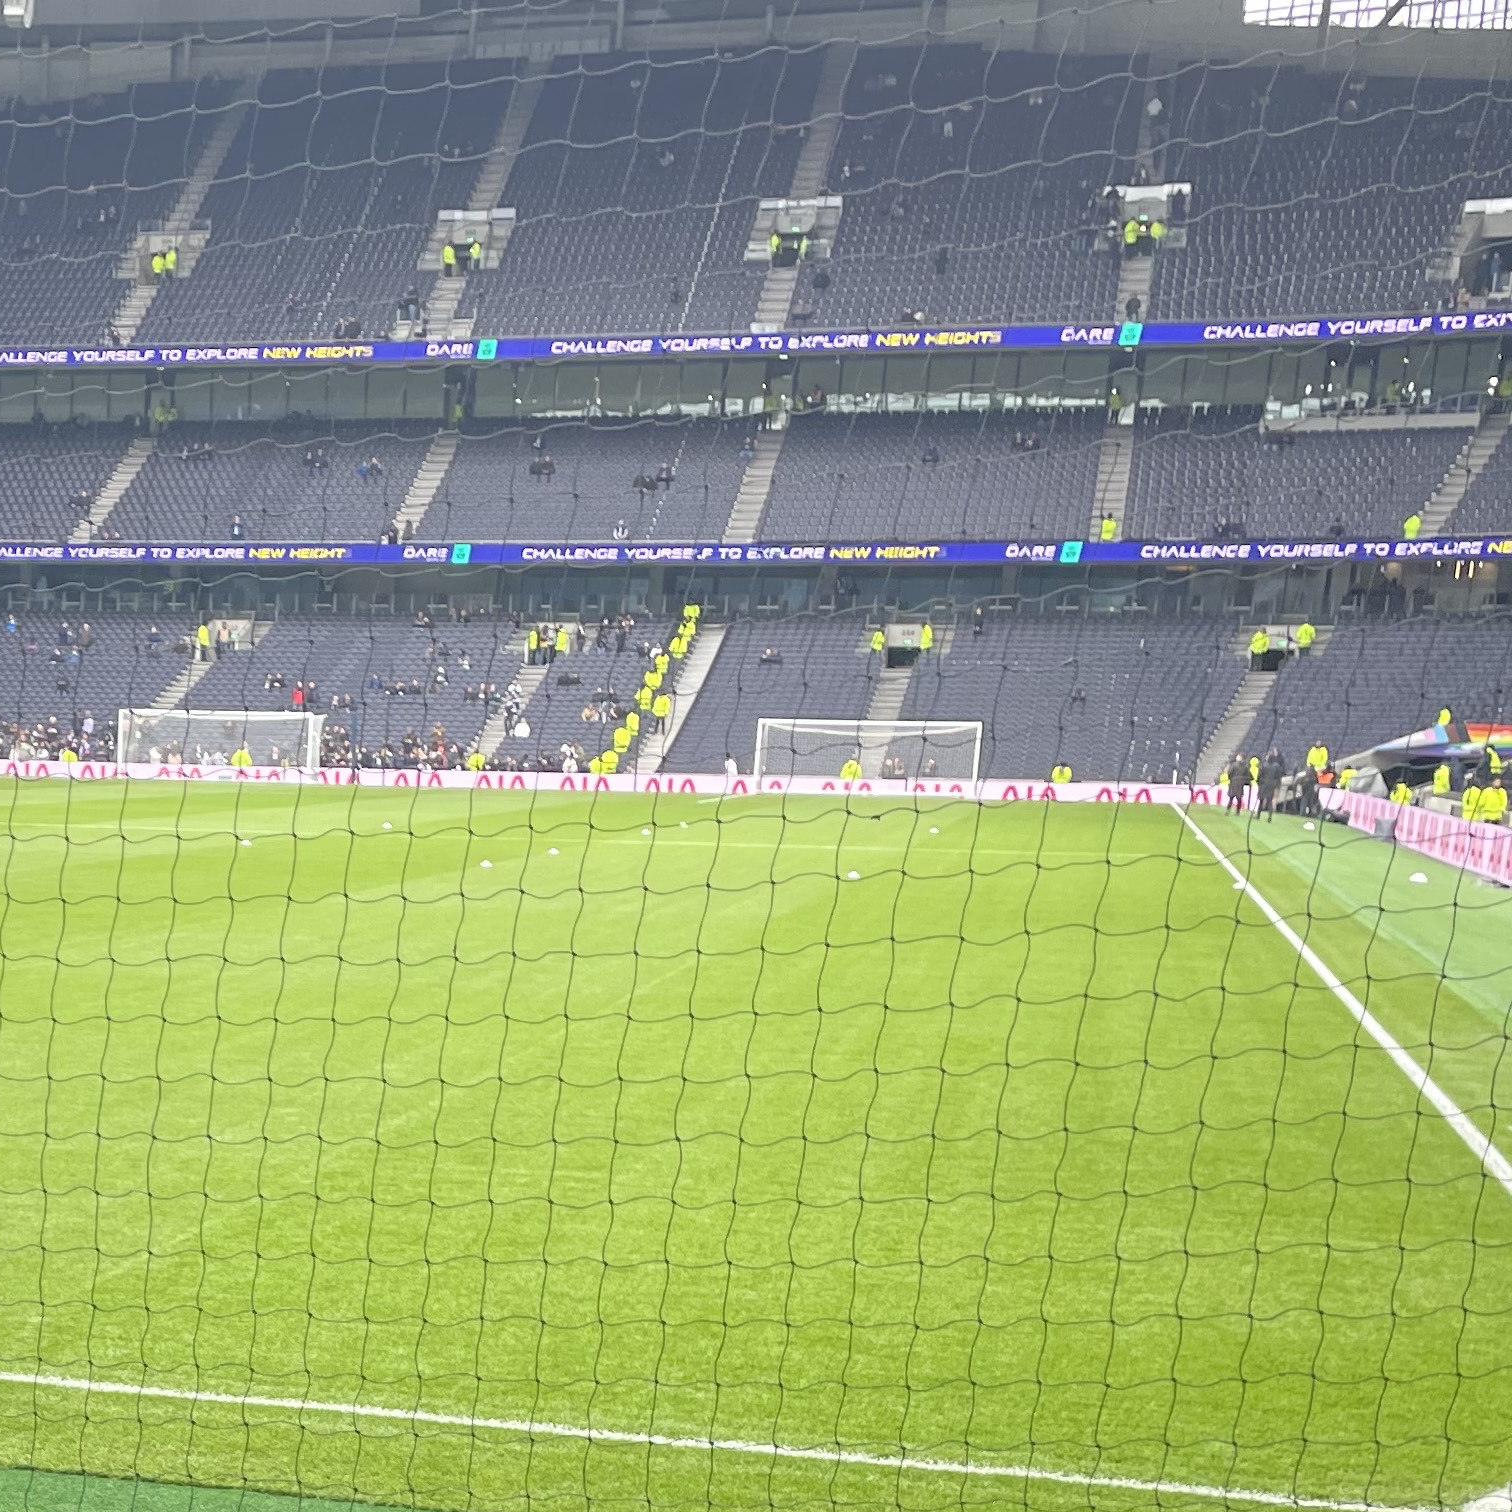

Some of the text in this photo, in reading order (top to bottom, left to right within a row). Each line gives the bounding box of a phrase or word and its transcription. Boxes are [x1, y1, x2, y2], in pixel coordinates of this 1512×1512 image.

[1204, 322, 1320, 339] CHALLENGE
[1327, 318, 1432, 335] YOURSELF
[1440, 315, 1467, 330] TO
[551, 340, 653, 354] CHALLENGE
[659, 337, 752, 352] YOURSELF
[758, 337, 782, 350] TO
[875, 332, 920, 347] NEW
[924, 331, 1002, 346] HEIGHTS
[72, 350, 154, 363] YOURSELF
[159, 349, 182, 360] TO
[186, 348, 258, 360] EXPLORE
[263, 347, 301, 359] NEW
[305, 346, 373, 358] HEIGHTS
[68, 546, 146, 559] YOURSELF
[150, 547, 172, 559] TO
[175, 547, 245, 560] EXPLORE
[248, 548, 286, 559] NEW
[522, 547, 618, 560] CHALLENGE
[718, 548, 742, 560] TO
[747, 547, 825, 560] EXPLORE
[829, 547, 871, 560] NEW
[1140, 545, 1250, 559] CHALLENGE
[1257, 544, 1356, 558] YOURSELF
[1363, 543, 1389, 557] TO
